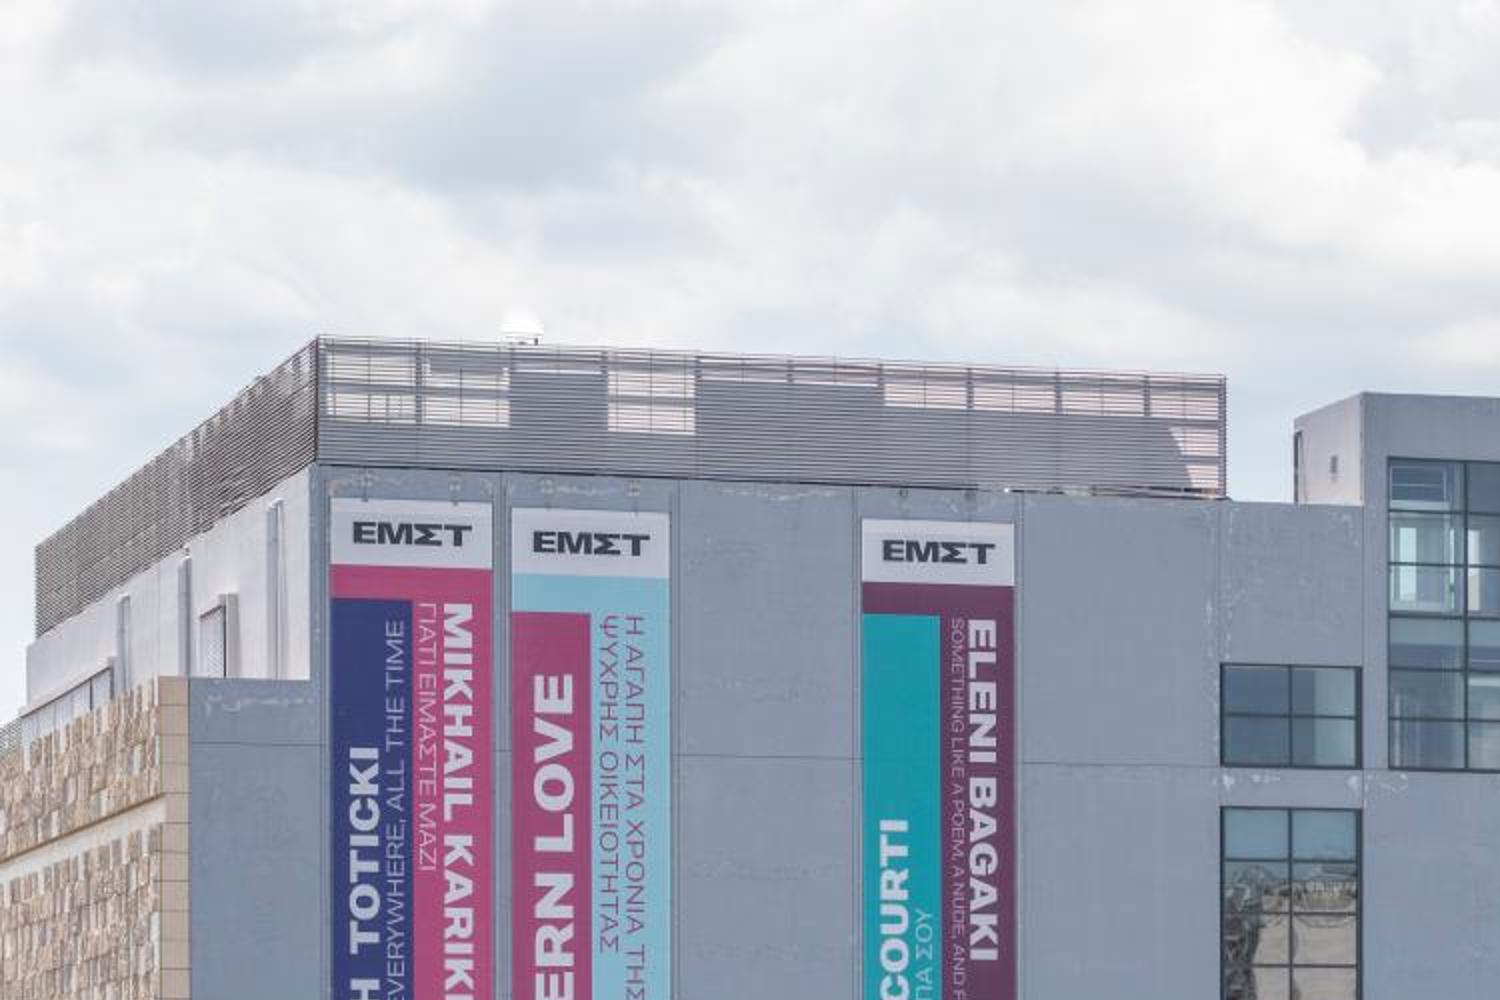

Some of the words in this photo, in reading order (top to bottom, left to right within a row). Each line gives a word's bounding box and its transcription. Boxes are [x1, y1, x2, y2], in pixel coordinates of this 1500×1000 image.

[353, 521, 473, 547] ΕΜΣΤ
[533, 530, 651, 557] ΕΜΣΤ
[882, 539, 996, 565] ΕΜΣΤ
[386, 619, 405, 687] TIME
[624, 615, 645, 636] Η
[598, 614, 620, 742] ΨΥΧΡΗΣ
[624, 643, 645, 744] ΑΓΑΠΗ
[967, 618, 998, 764] ELENI
[386, 696, 405, 753] THE
[418, 673, 437, 796] ΕΙΜΑΣΤΕ
[443, 603, 473, 822] MIKHAIL
[386, 759, 405, 811] ALL
[533, 673, 576, 852] LOVE
[624, 753, 645, 810] ΣΤΑ
[951, 737, 966, 779] LIKE
[349, 746, 381, 955] TOTICKI
[418, 803, 437, 871] ΜΑΖΙ
[598, 751, 620, 954] ΟΙΚΕΙΟΤΗΤΑΣ
[968, 777, 999, 961] BAGAKI
[624, 819, 646, 935] ΧΡΟΝΙΑ
[914, 908, 934, 961] ΣΟΥ
[952, 943, 966, 985] AND
